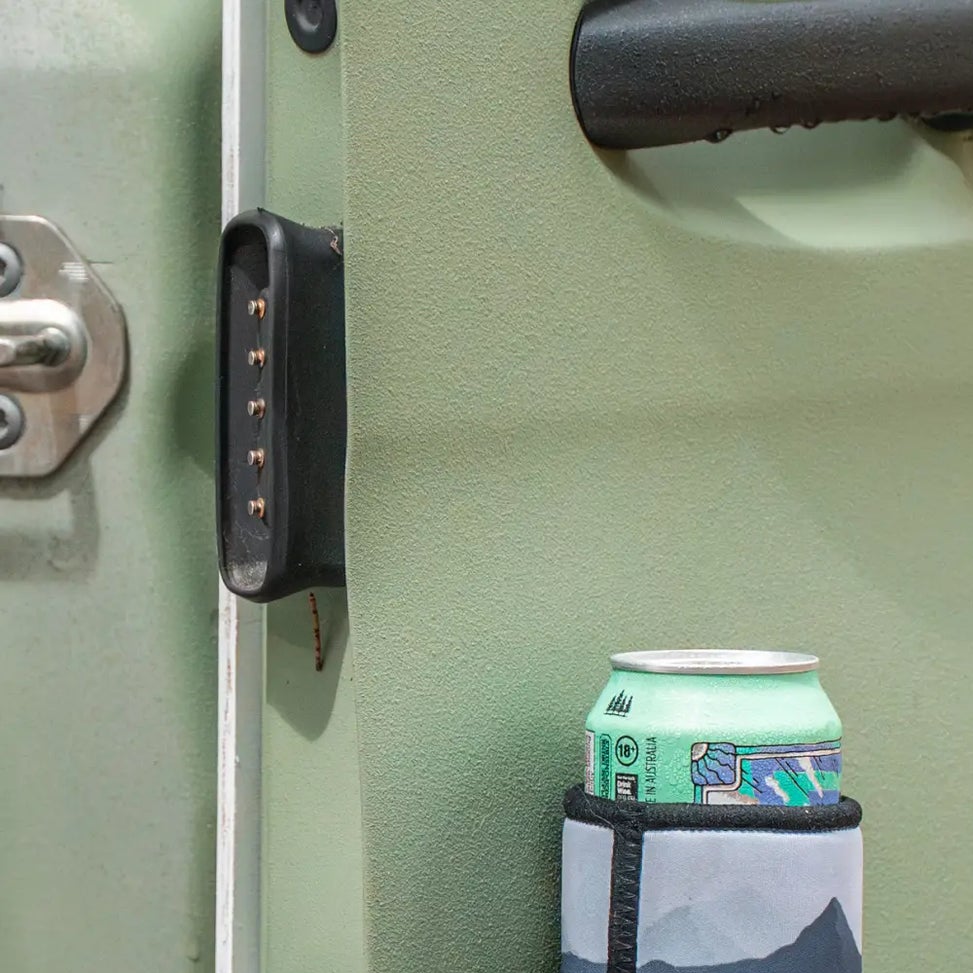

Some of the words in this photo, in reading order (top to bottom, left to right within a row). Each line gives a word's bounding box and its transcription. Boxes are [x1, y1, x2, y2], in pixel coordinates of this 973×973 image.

[618, 744, 635, 758] 18+
[645, 736, 657, 782] AUSTRALIA
[646, 785, 656, 795] IN
